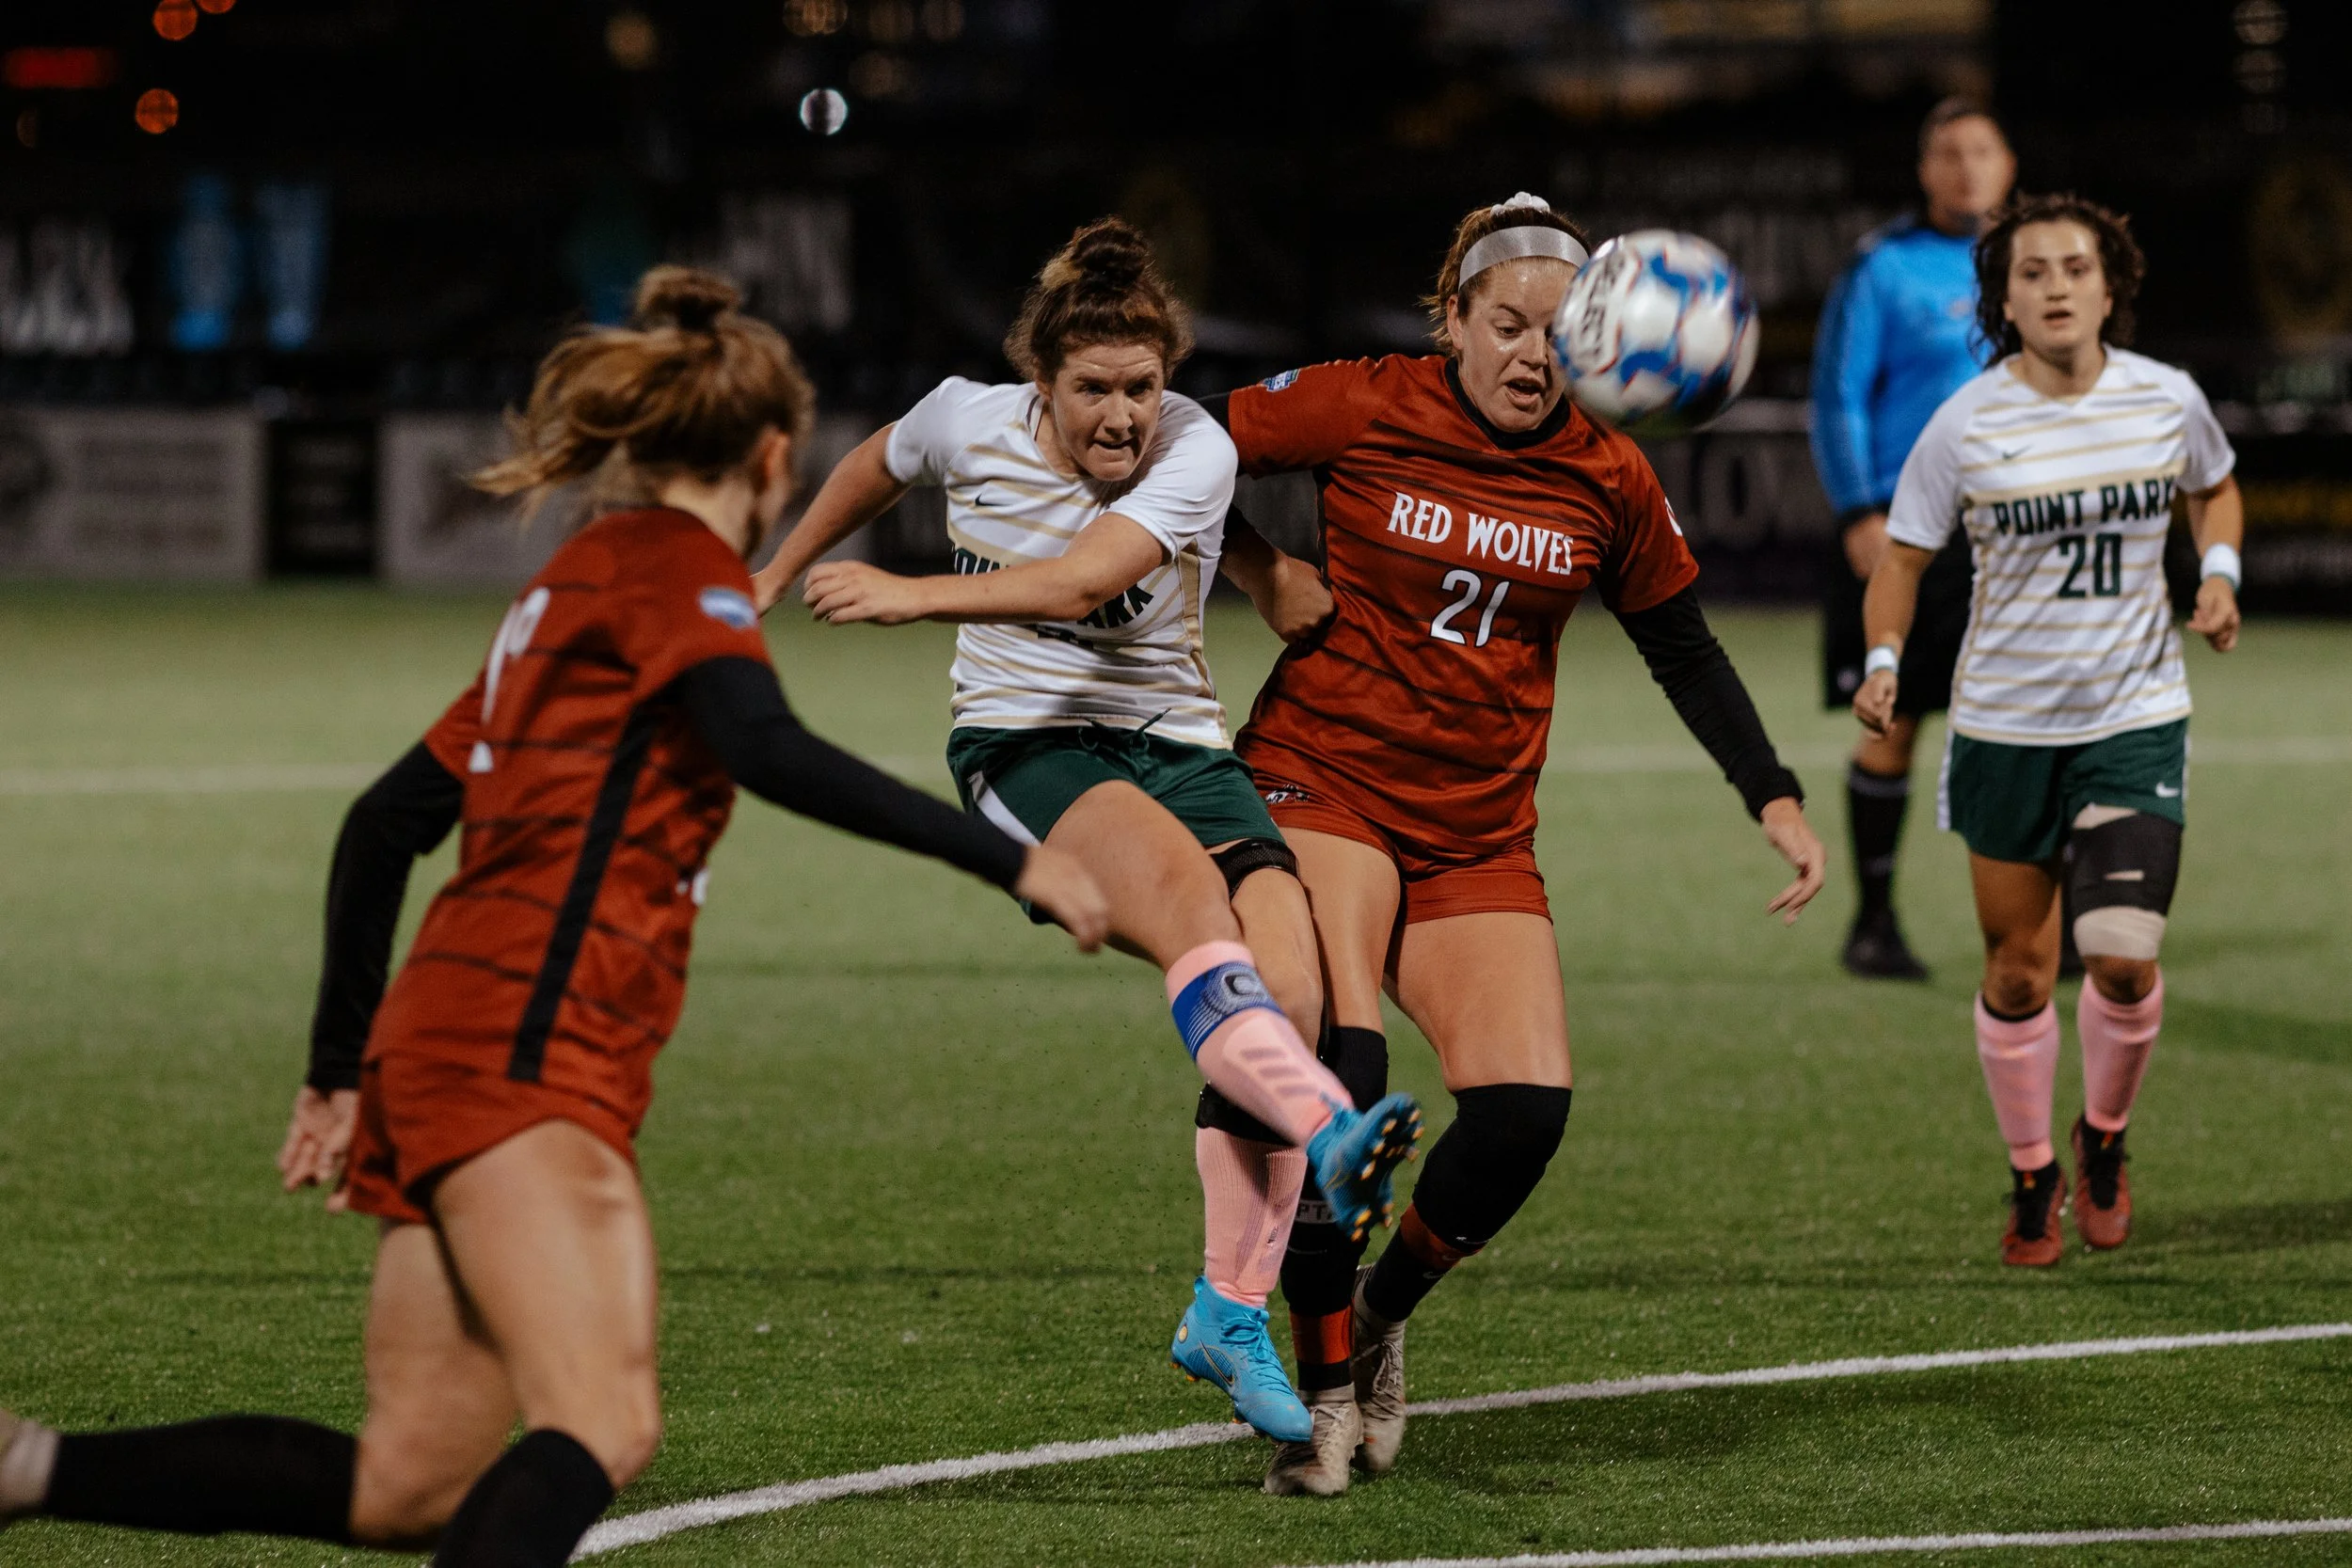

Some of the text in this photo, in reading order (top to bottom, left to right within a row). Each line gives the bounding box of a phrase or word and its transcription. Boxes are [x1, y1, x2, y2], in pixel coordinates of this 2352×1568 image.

[1387, 491, 1574, 576] RED WOLVES
[1993, 475, 2175, 535] POINT PARK
[2058, 532, 2122, 598] 20
[1076, 583, 1154, 629] ARK
[1429, 568, 1510, 648] 21
